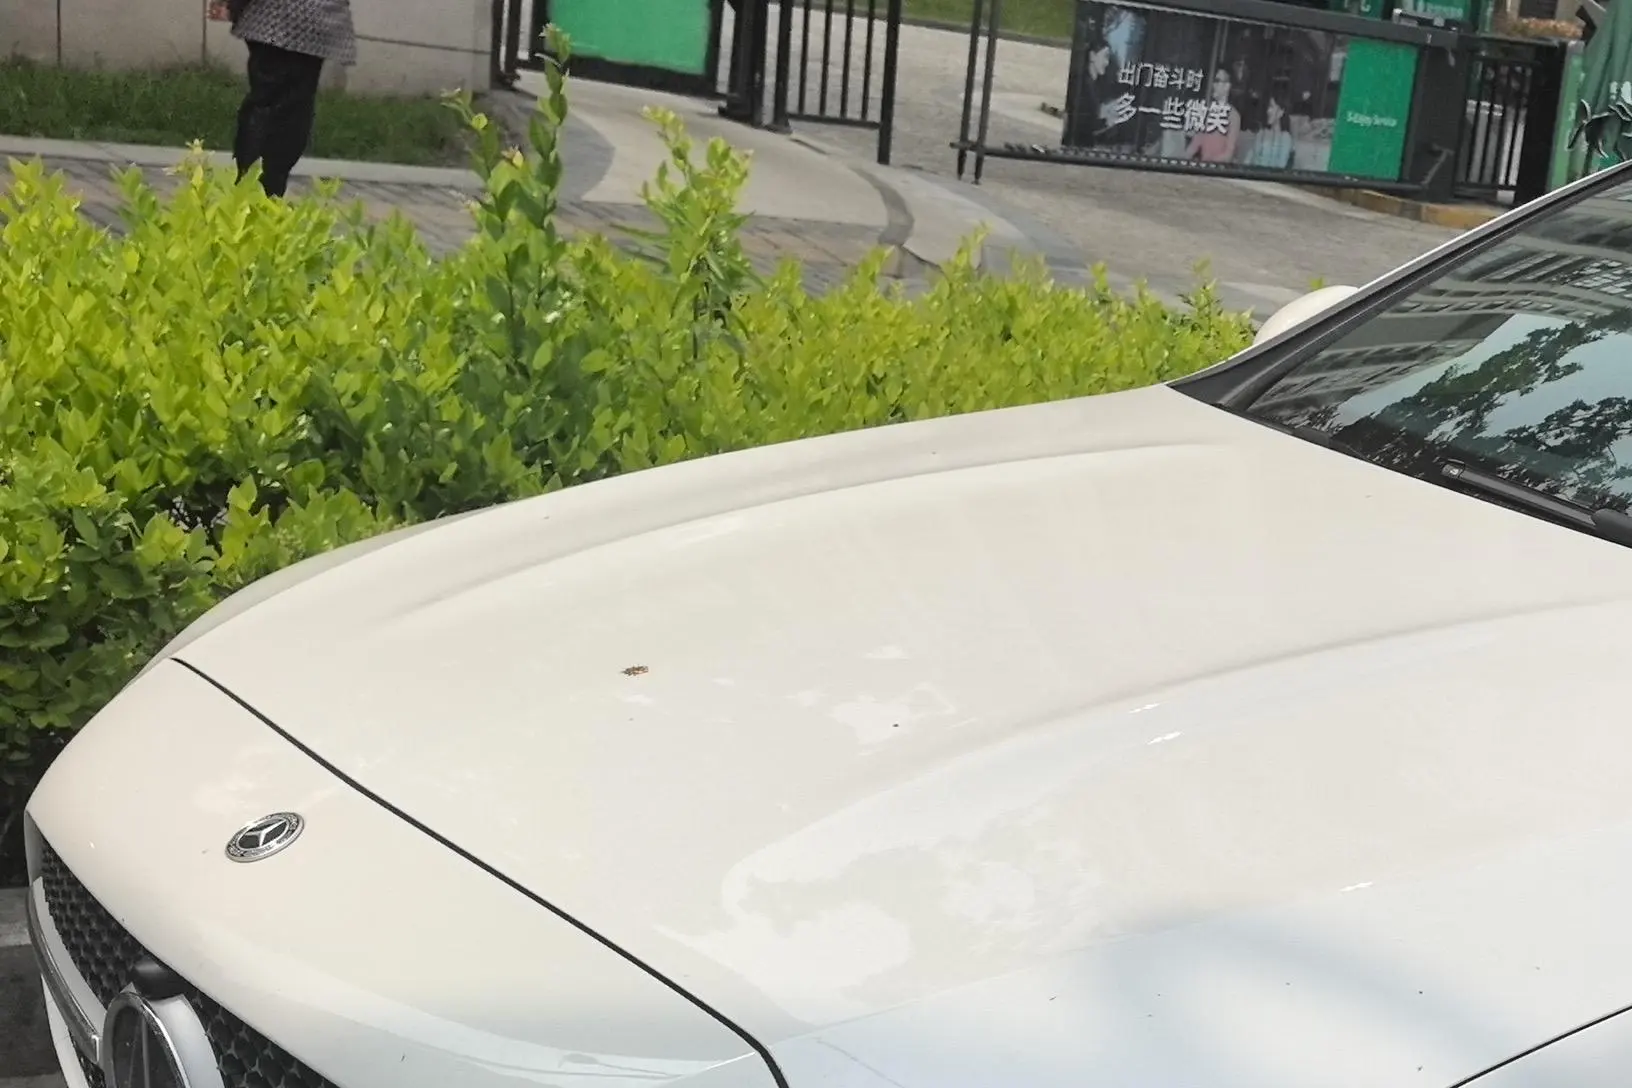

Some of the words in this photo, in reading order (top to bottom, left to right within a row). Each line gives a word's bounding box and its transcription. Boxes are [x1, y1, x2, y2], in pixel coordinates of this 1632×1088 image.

[1118, 61, 1203, 92] 出门奋斗时
[1115, 92, 1231, 134] 多一些微笑
